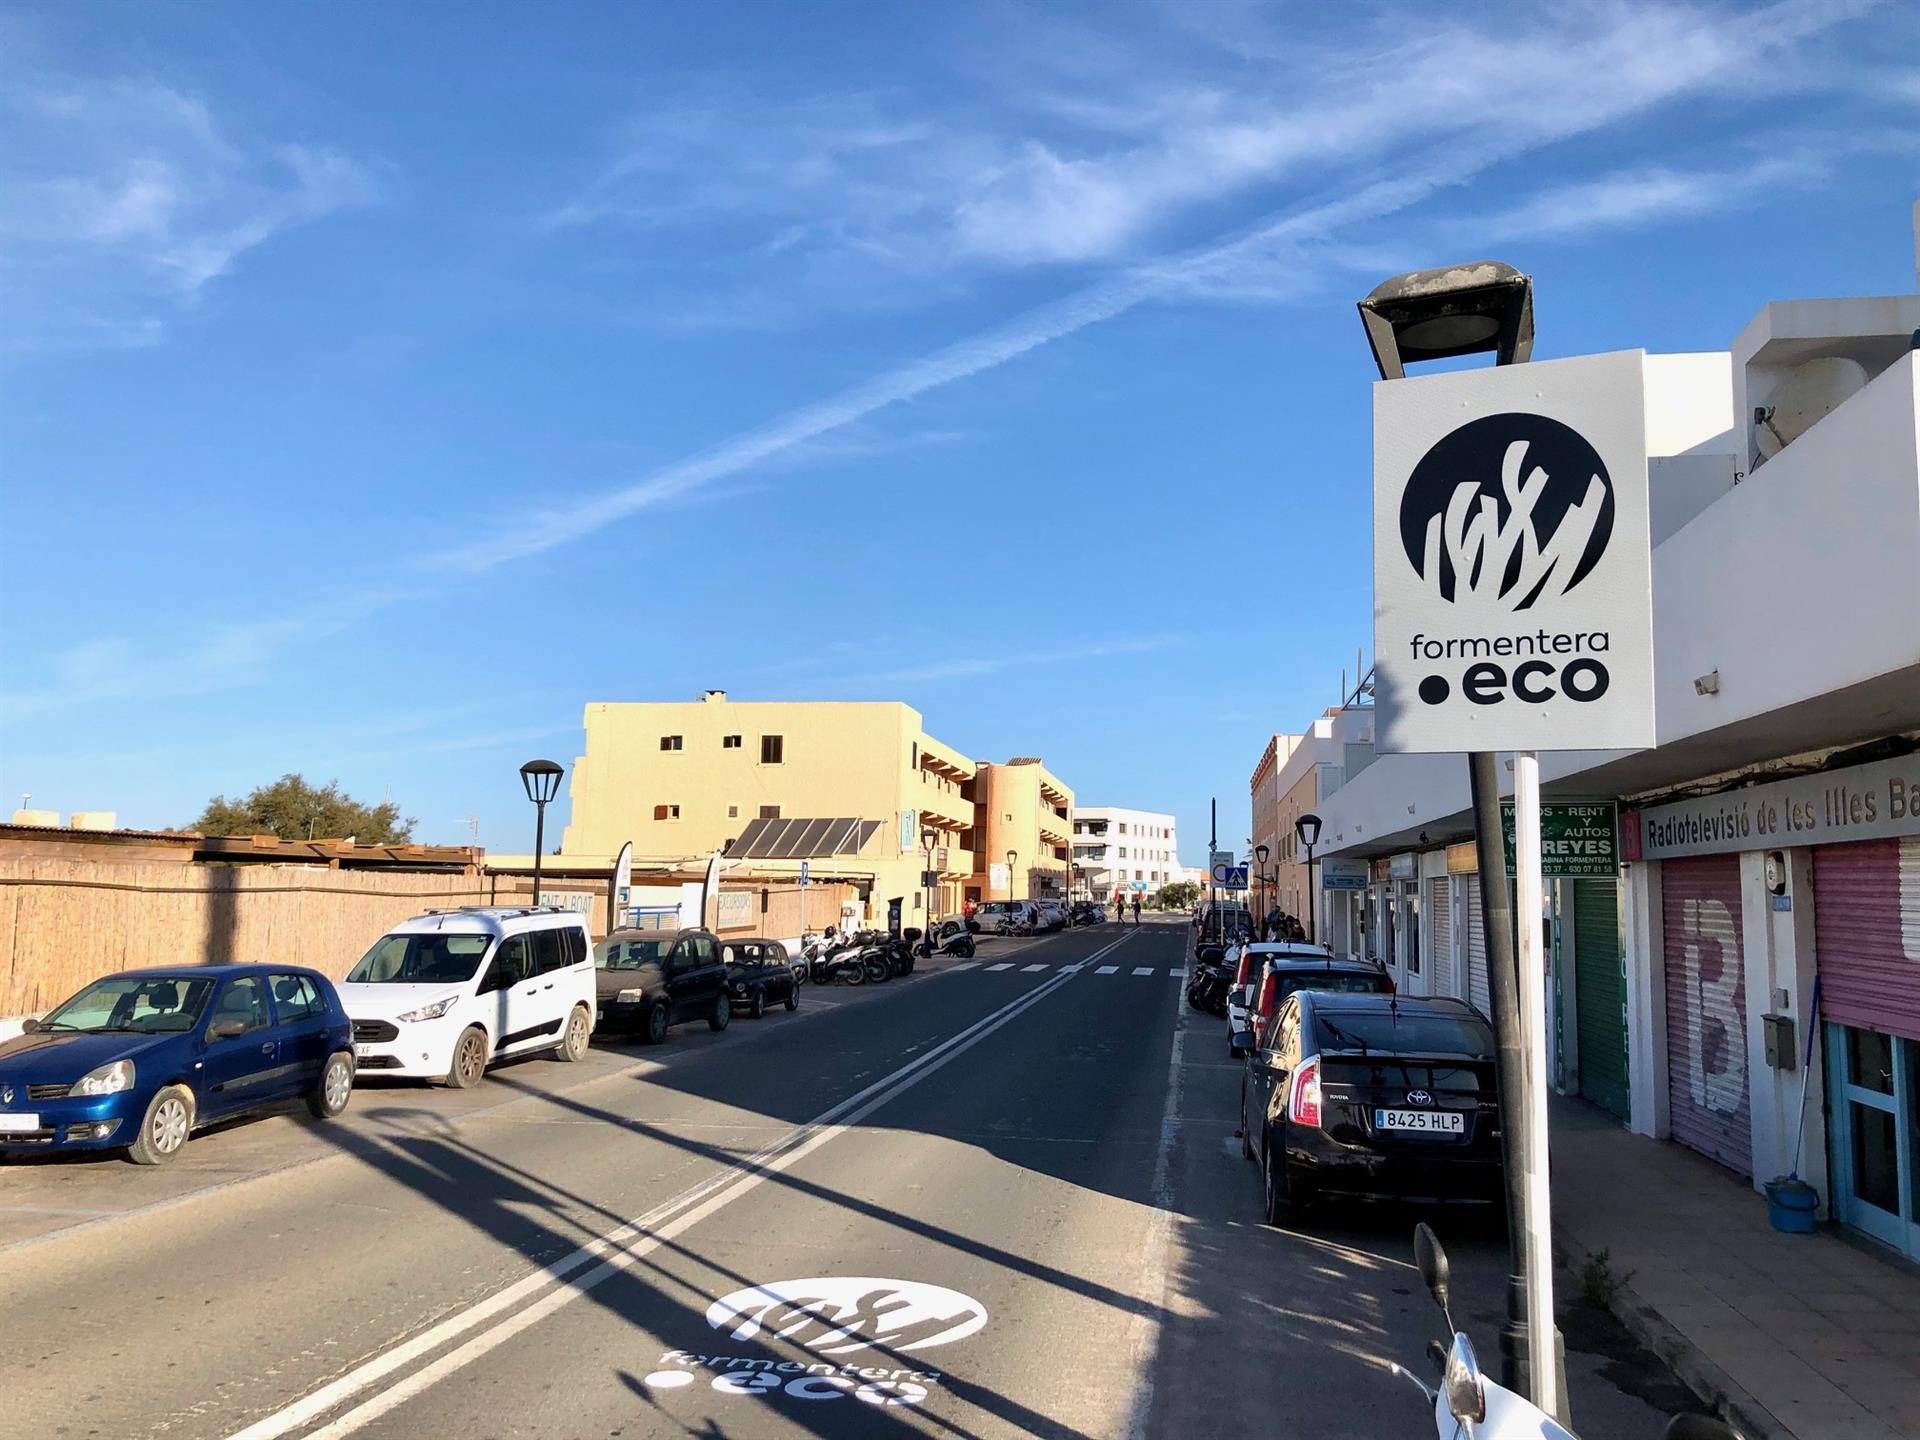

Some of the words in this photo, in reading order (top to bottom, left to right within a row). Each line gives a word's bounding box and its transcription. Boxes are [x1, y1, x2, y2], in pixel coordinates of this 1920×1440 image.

[1410, 629, 1610, 660] formentera
[1568, 807, 1606, 817] RENT
[1648, 801, 1751, 849] Radiotelevisió
[1757, 800, 1778, 835] de
[1785, 796, 1816, 832] les
[1825, 786, 1877, 827] Illes
[1582, 817, 1592, 827] Y
[1564, 827, 1611, 837] AUTOS
[1542, 840, 1612, 855] REYES
[1565, 856, 1612, 864] FORMENTERA
[1543, 865, 1552, 873] 33
[1553, 865, 1562, 873] 37
[1387, 1112, 1427, 1128] 8425
[1431, 1113, 1460, 1130] HLP
[658, 1350, 942, 1383] formentera
